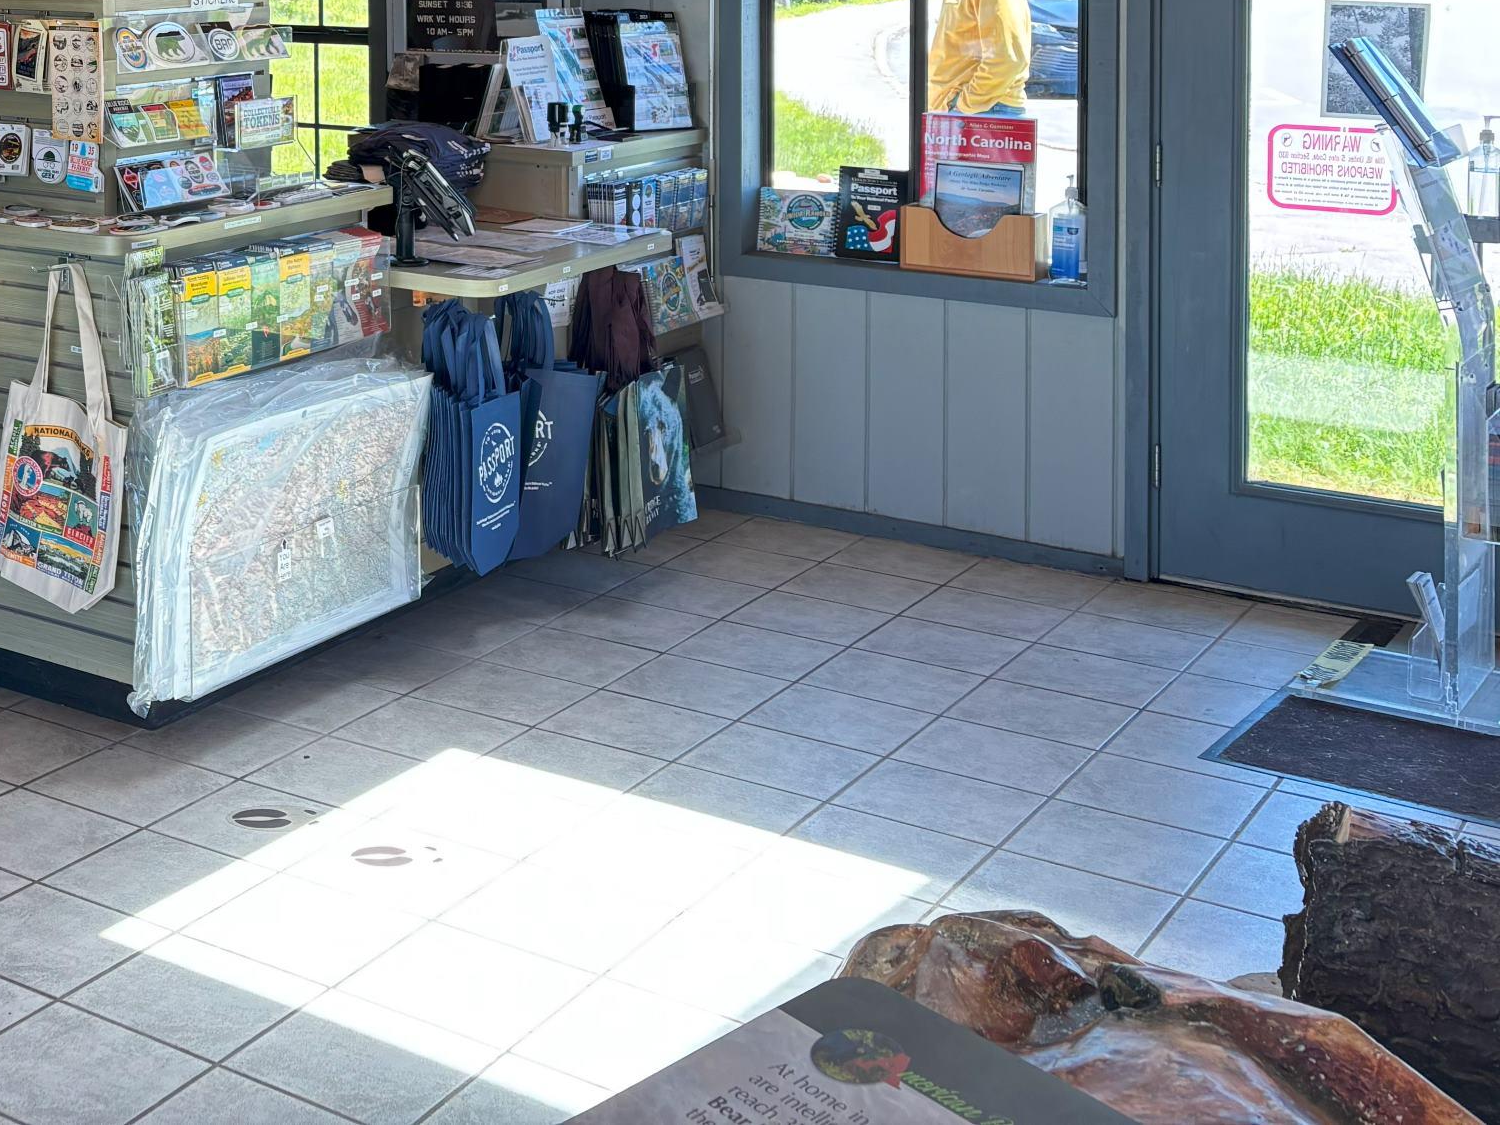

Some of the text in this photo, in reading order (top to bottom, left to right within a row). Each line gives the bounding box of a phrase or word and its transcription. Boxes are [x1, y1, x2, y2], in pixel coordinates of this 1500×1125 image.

[417, 15, 433, 23] WRK
[214, 38, 232, 52] BRP
[516, 44, 544, 56] Passport
[243, 114, 280, 128] TOKENS
[72, 143, 78, 152] 19
[88, 146, 94, 155] 35
[924, 133, 1032, 151] North Carolina
[851, 183, 898, 196] Passport
[479, 436, 515, 486] PASSPORT
[1, 495, 10, 520] ZION
[66, 528, 94, 546] GLACIER
[38, 561, 84, 586] GRAND TETON
[748, 1075, 779, 1095] are
[768, 1063, 869, 1125] At home in
[708, 1096, 752, 1125] Bear
[728, 1085, 778, 1120] reach
